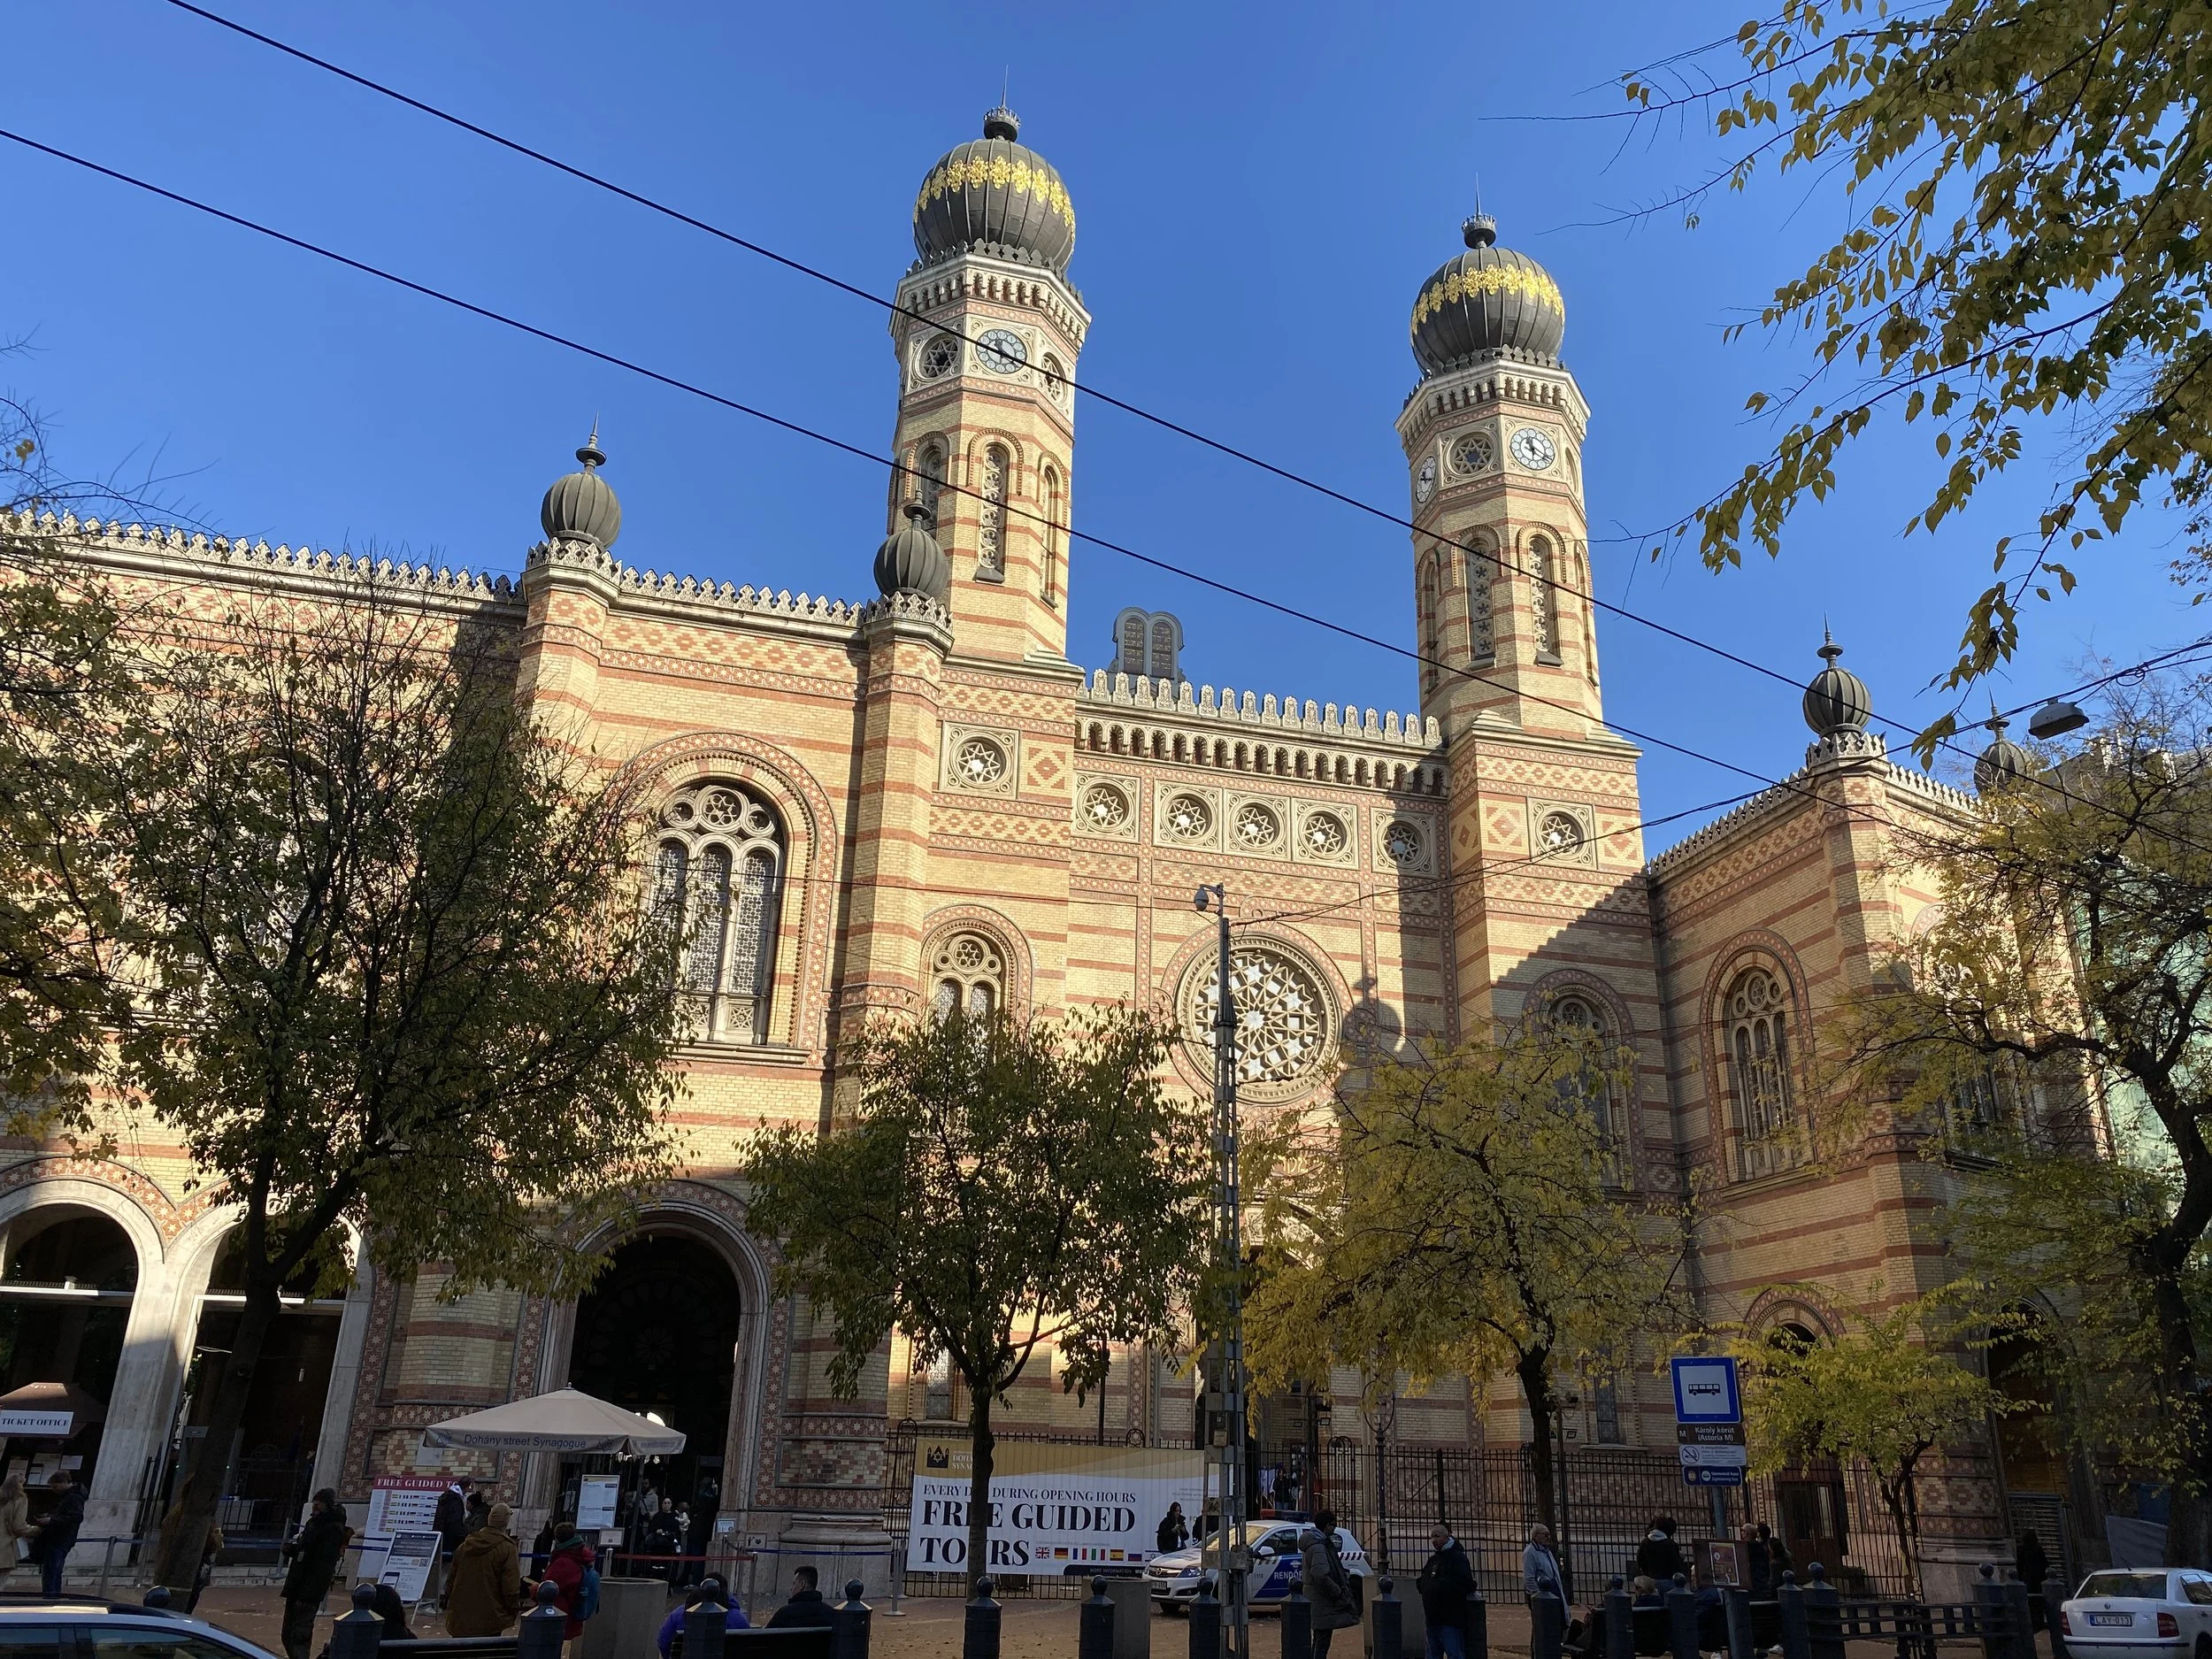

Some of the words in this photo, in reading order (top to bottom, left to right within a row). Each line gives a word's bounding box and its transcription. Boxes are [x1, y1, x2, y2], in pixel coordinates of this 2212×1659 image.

[464, 1434, 501, 1447] Dohány
[503, 1437, 531, 1447] street
[533, 1437, 587, 1449] Synagogue
[377, 1479, 403, 1487] FREE
[404, 1479, 443, 1488] GUIDED
[924, 1484, 962, 1496] EVERY
[993, 1487, 1038, 1500] DURING
[1041, 1489, 1094, 1502] OPENING
[1096, 1491, 1136, 1503] HOURS
[1011, 1503, 1135, 1532] GUIDED
[919, 1537, 1029, 1567] TORS
